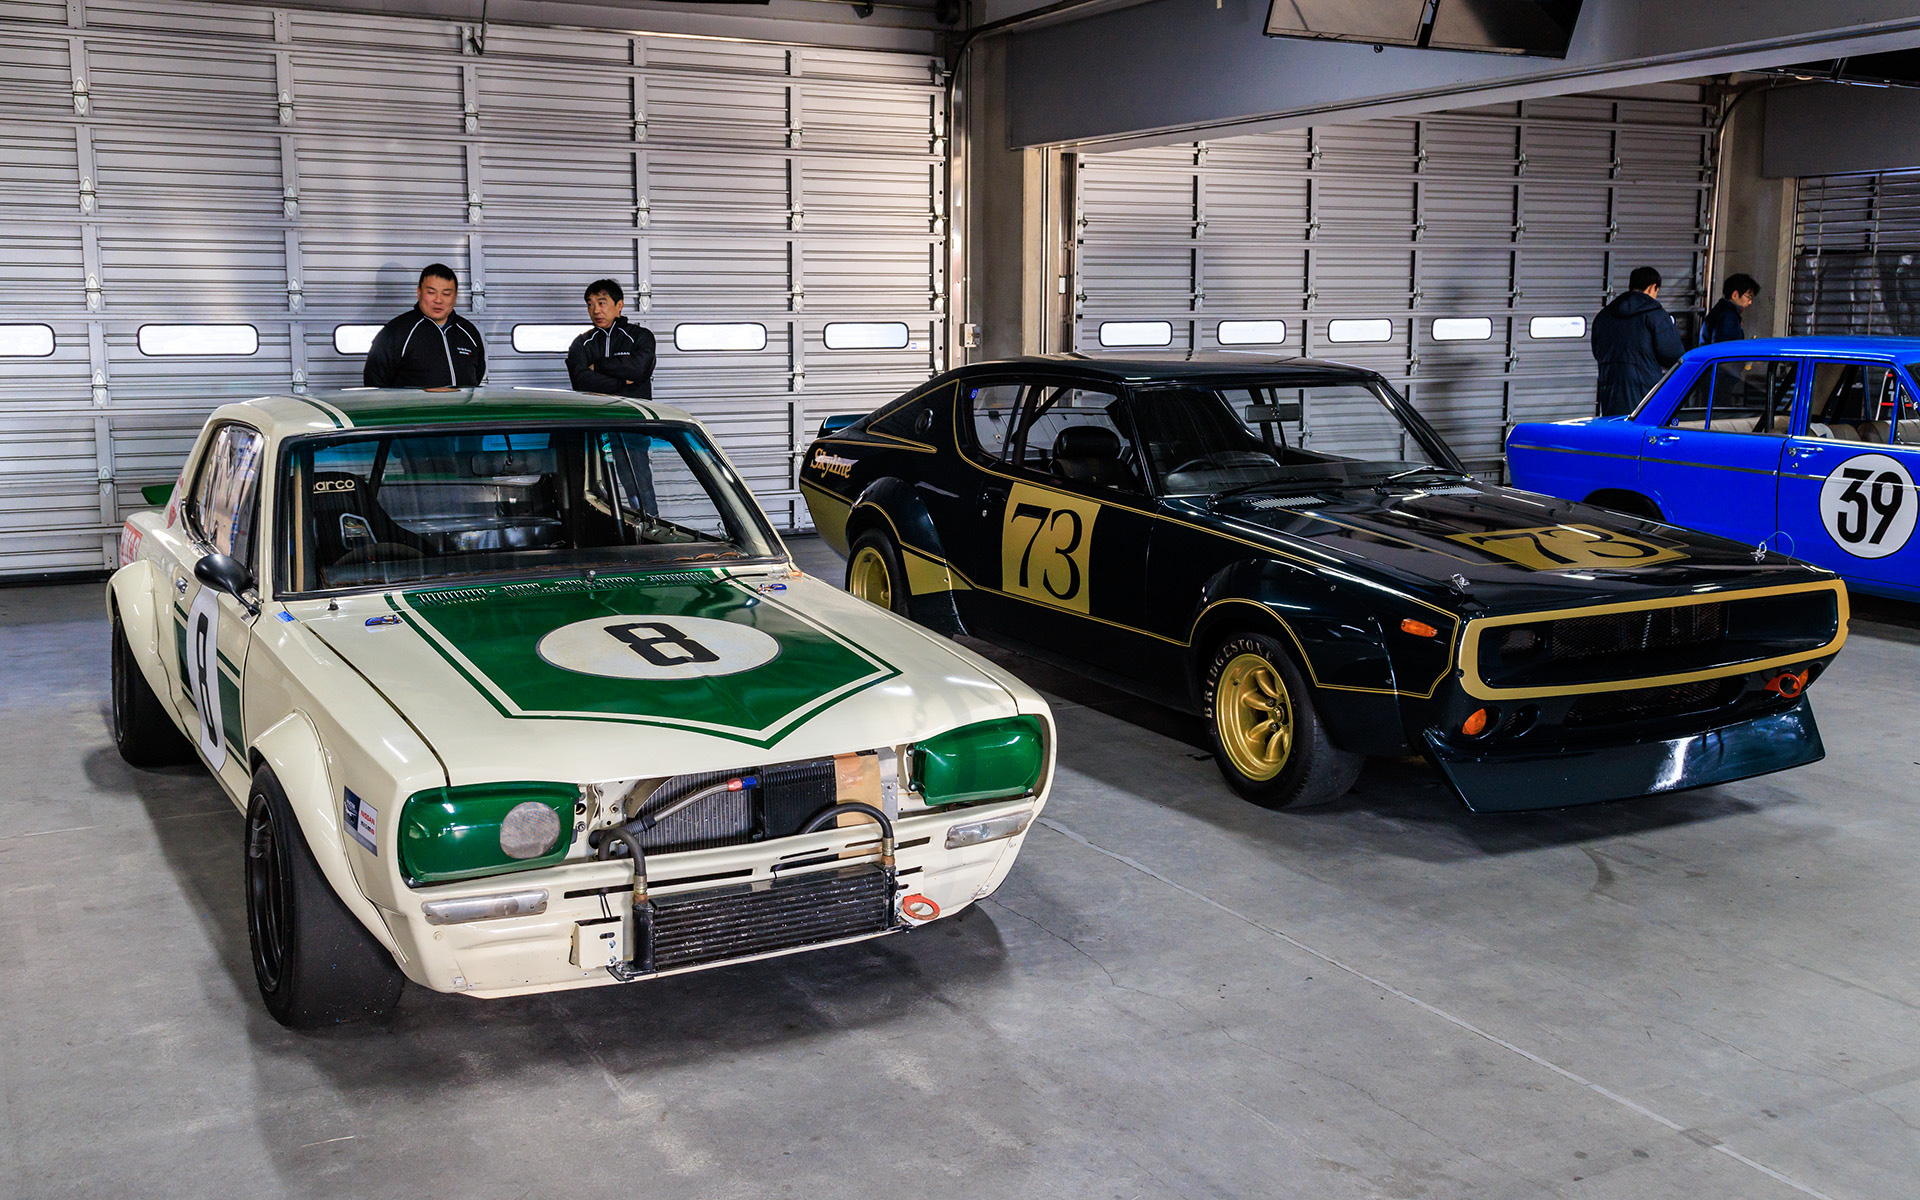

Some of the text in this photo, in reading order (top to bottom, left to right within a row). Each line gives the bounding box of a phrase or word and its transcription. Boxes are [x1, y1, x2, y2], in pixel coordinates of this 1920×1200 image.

[313, 479, 356, 491] arco
[810, 447, 853, 479] Skyline
[1837, 467, 1904, 545] 39
[1011, 502, 1083, 601] 73
[1469, 528, 1660, 565] 73
[603, 612, 721, 667] 8
[196, 611, 218, 748] 8
[1204, 638, 1274, 719] BRIDGESTONE
